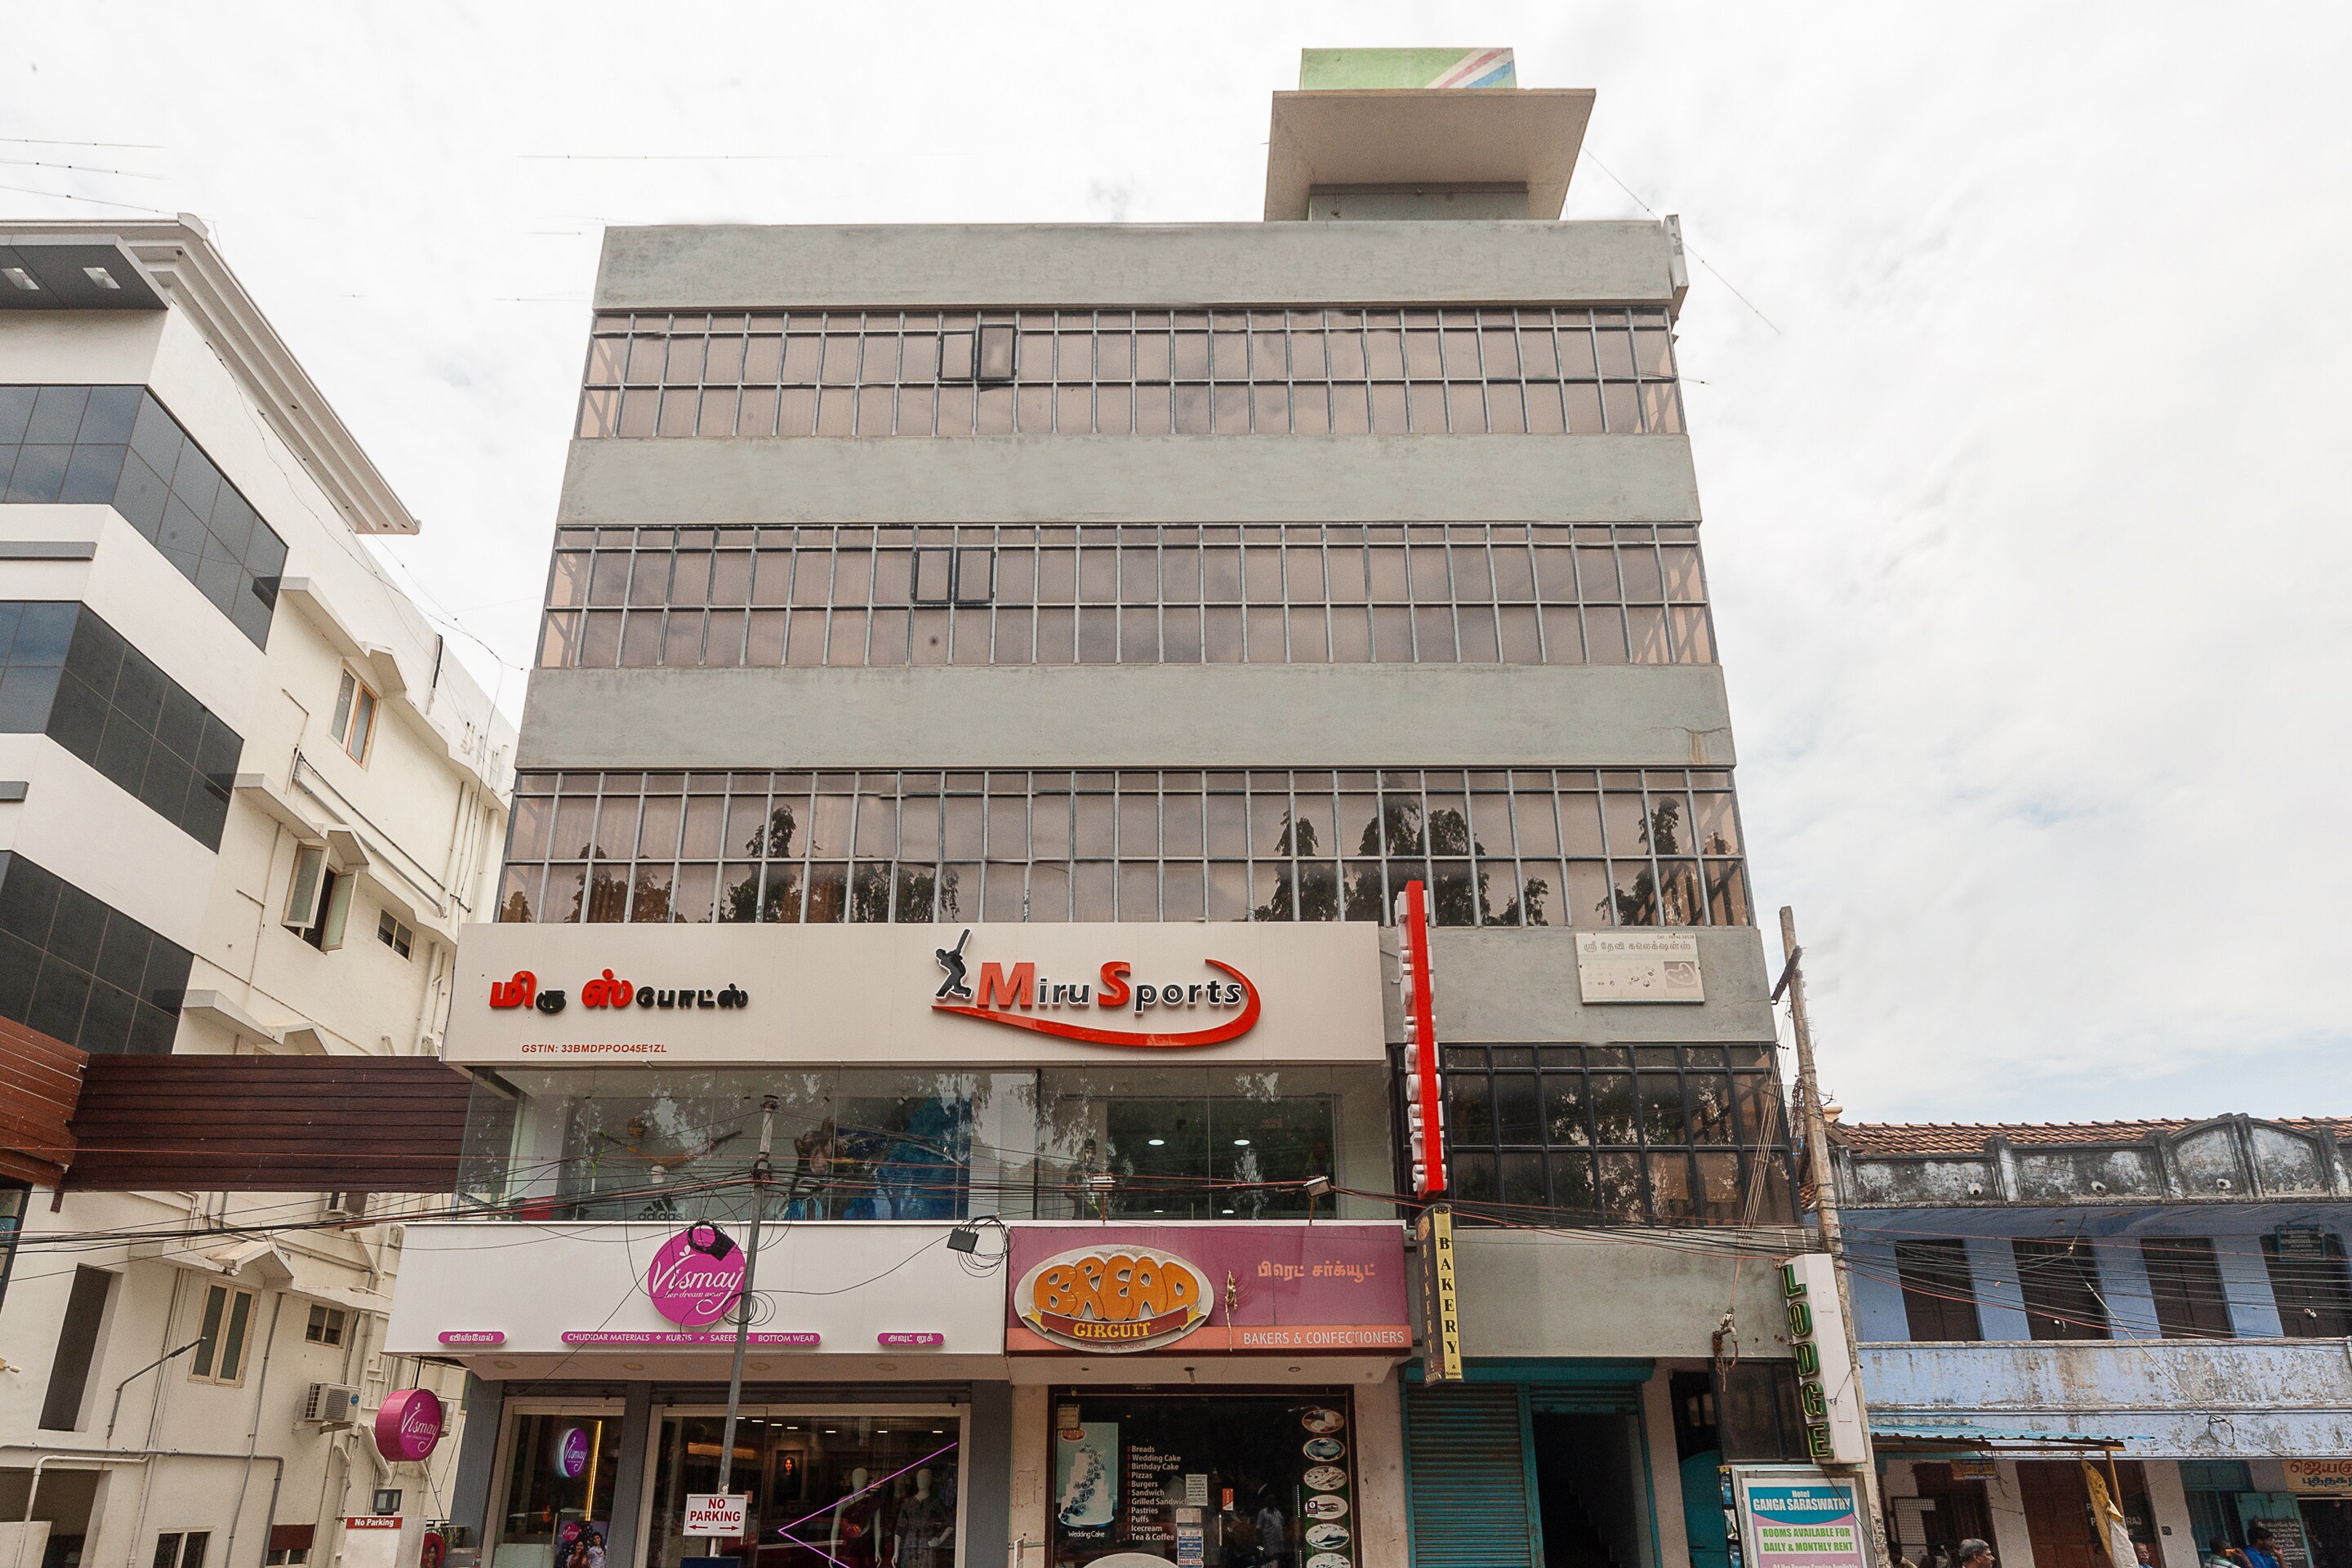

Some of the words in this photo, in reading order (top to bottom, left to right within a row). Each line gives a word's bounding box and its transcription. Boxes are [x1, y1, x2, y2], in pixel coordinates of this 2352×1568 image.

[489, 970, 567, 1014] மிரு
[977, 962, 1090, 1009] Miru
[1098, 960, 1242, 1015] Sports
[522, 1045, 559, 1053] GSTIN:
[652, 1254, 744, 1315] Vismay
[1033, 1255, 1200, 1322] BREAD
[1438, 1237, 1458, 1354] BAKERY
[1073, 1321, 1152, 1339] CIRCUIT
[609, 1334, 650, 1342] MATERIALS
[666, 1334, 692, 1342] KURTIS
[1243, 1332, 1290, 1344] BAKERS
[1294, 1332, 1302, 1344] &
[1306, 1331, 1405, 1343] CONFECTIONERS
[1780, 1263, 1834, 1459] LODGE
[401, 1410, 439, 1452] Vismay
[1132, 1454, 1163, 1463] Wedding
[1131, 1463, 1161, 1471] Birthday
[1131, 1481, 1158, 1489] Burgers
[1792, 1490, 1810, 1498] Hotel
[708, 1498, 726, 1509] NO
[1753, 1499, 1786, 1511] GANGA
[1788, 1498, 1851, 1511] SARASWATHY
[690, 1511, 741, 1522] PARKING
[367, 1518, 394, 1527] Parking
[1068, 1530, 1090, 1539] Wedding
[1152, 1533, 1174, 1541] Coffee
[1762, 1528, 1792, 1538] ROOMS
[1793, 1527, 1833, 1537] AVAILABLE
[1836, 1527, 1851, 1537] FOR
[1764, 1543, 1786, 1552] DAILY
[1788, 1544, 1793, 1552] &
[1795, 1542, 1832, 1551] MONTHLY
[1833, 1542, 1853, 1551] RENT
